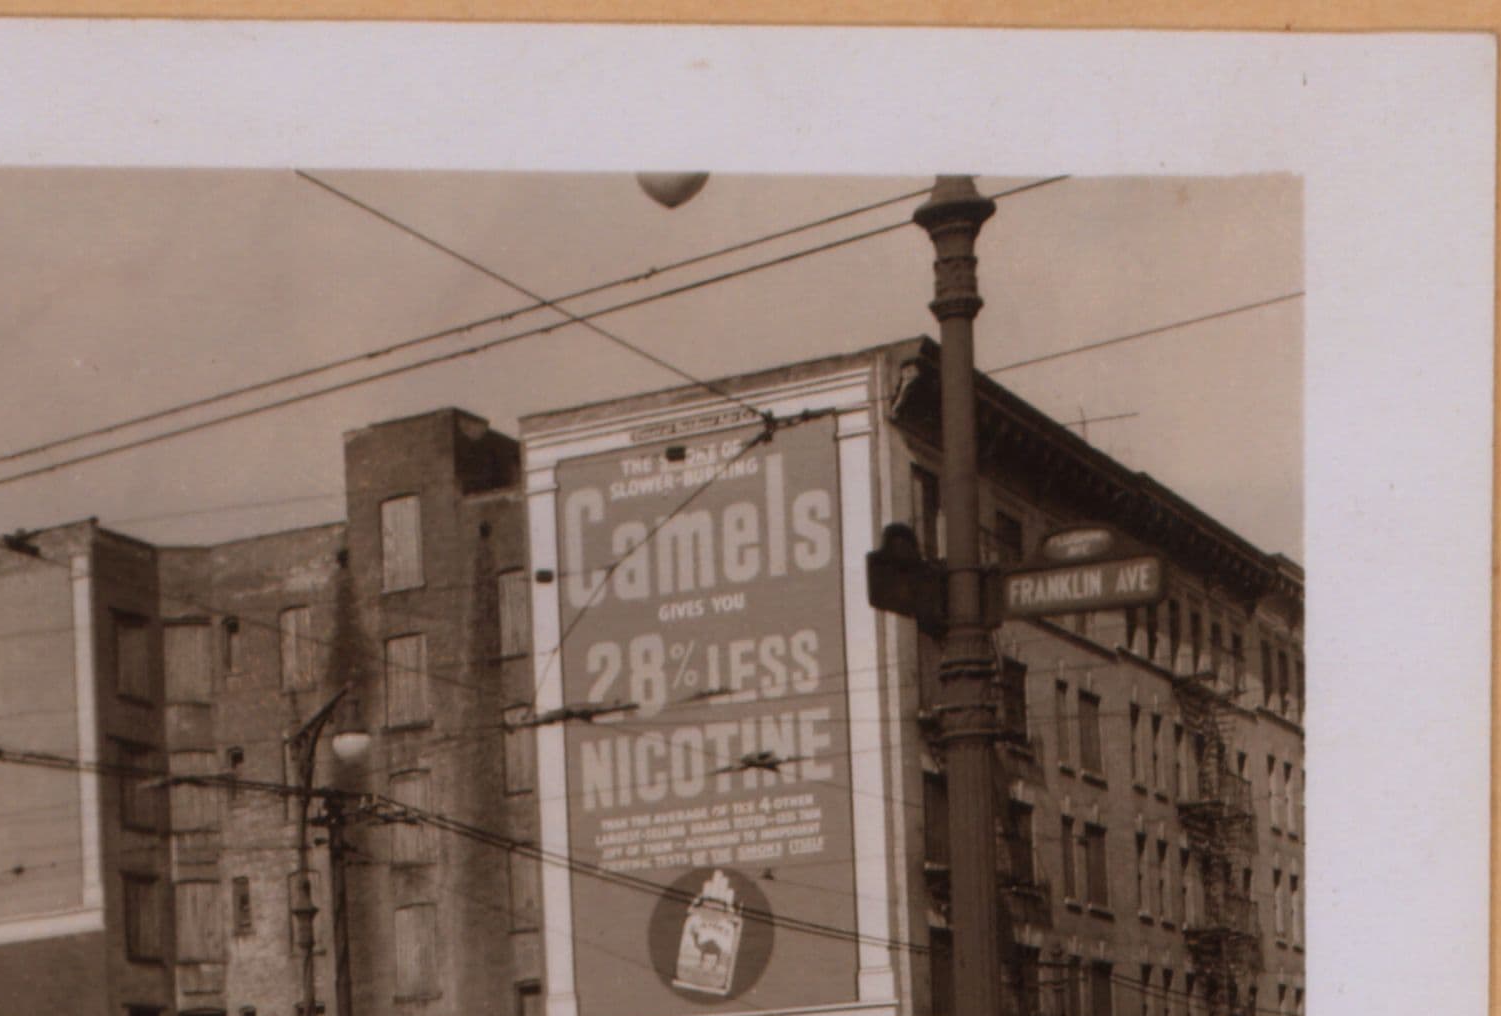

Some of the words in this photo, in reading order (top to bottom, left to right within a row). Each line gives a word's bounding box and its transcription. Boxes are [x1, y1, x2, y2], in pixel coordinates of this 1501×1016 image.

[621, 456, 653, 476] THE
[565, 453, 834, 609] Camels
[658, 597, 704, 622] GIVES
[711, 592, 745, 614] YOU
[1010, 570, 1102, 607] FRANKLIN
[1115, 564, 1151, 593] AVE
[707, 629, 821, 706] LESS
[580, 707, 833, 811] NICOTINE
